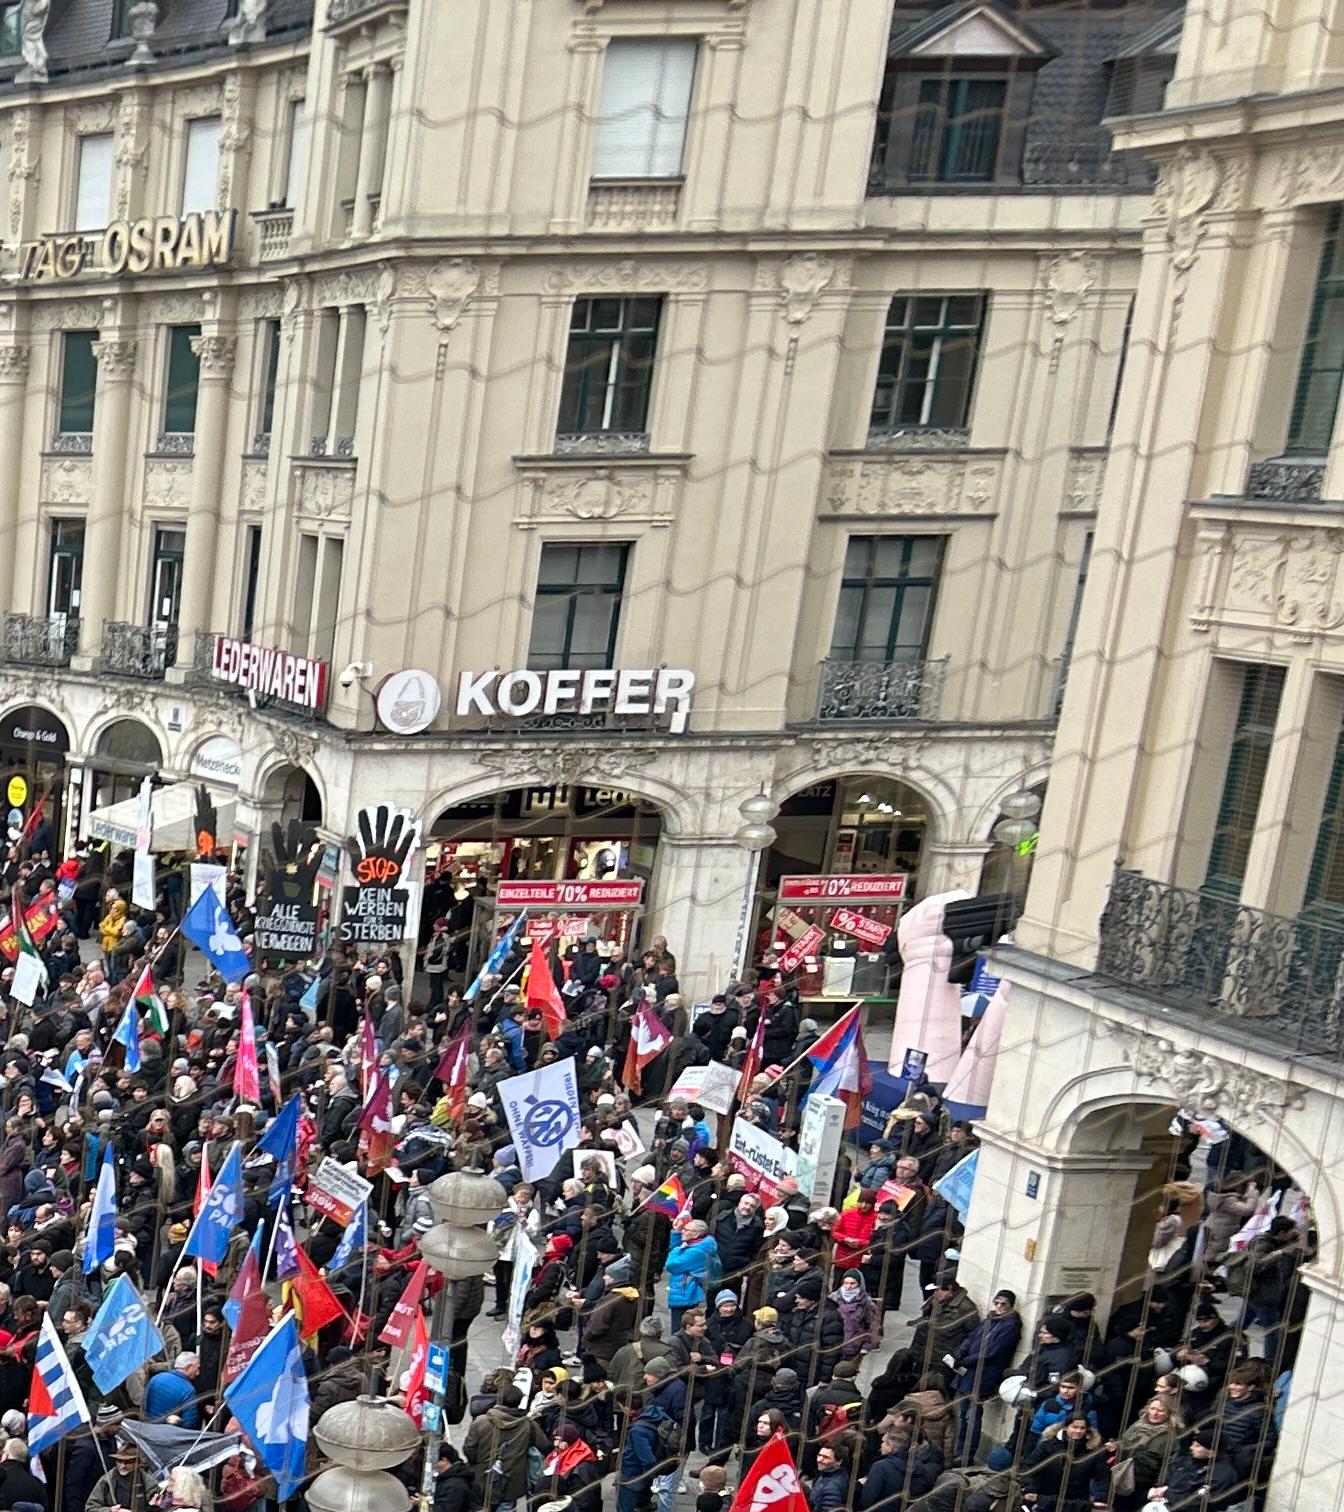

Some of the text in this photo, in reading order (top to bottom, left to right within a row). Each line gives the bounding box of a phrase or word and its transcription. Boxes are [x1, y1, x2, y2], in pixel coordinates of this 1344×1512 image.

[21, 236, 86, 281] TAG
[103, 207, 238, 275] OSRAM
[213, 637, 320, 709] LEDERWAREN
[455, 668, 696, 731] KOFFER
[356, 857, 399, 884] STOP
[358, 887, 392, 903] KEIN
[556, 884, 588, 904] 70%
[589, 886, 639, 899] REDUZIERT
[820, 878, 851, 897] 70%
[850, 881, 902, 893] REDUZIERT
[270, 903, 302, 921] ALLE
[343, 901, 404, 918] WERBEN
[339, 921, 403, 942] STERBEN
